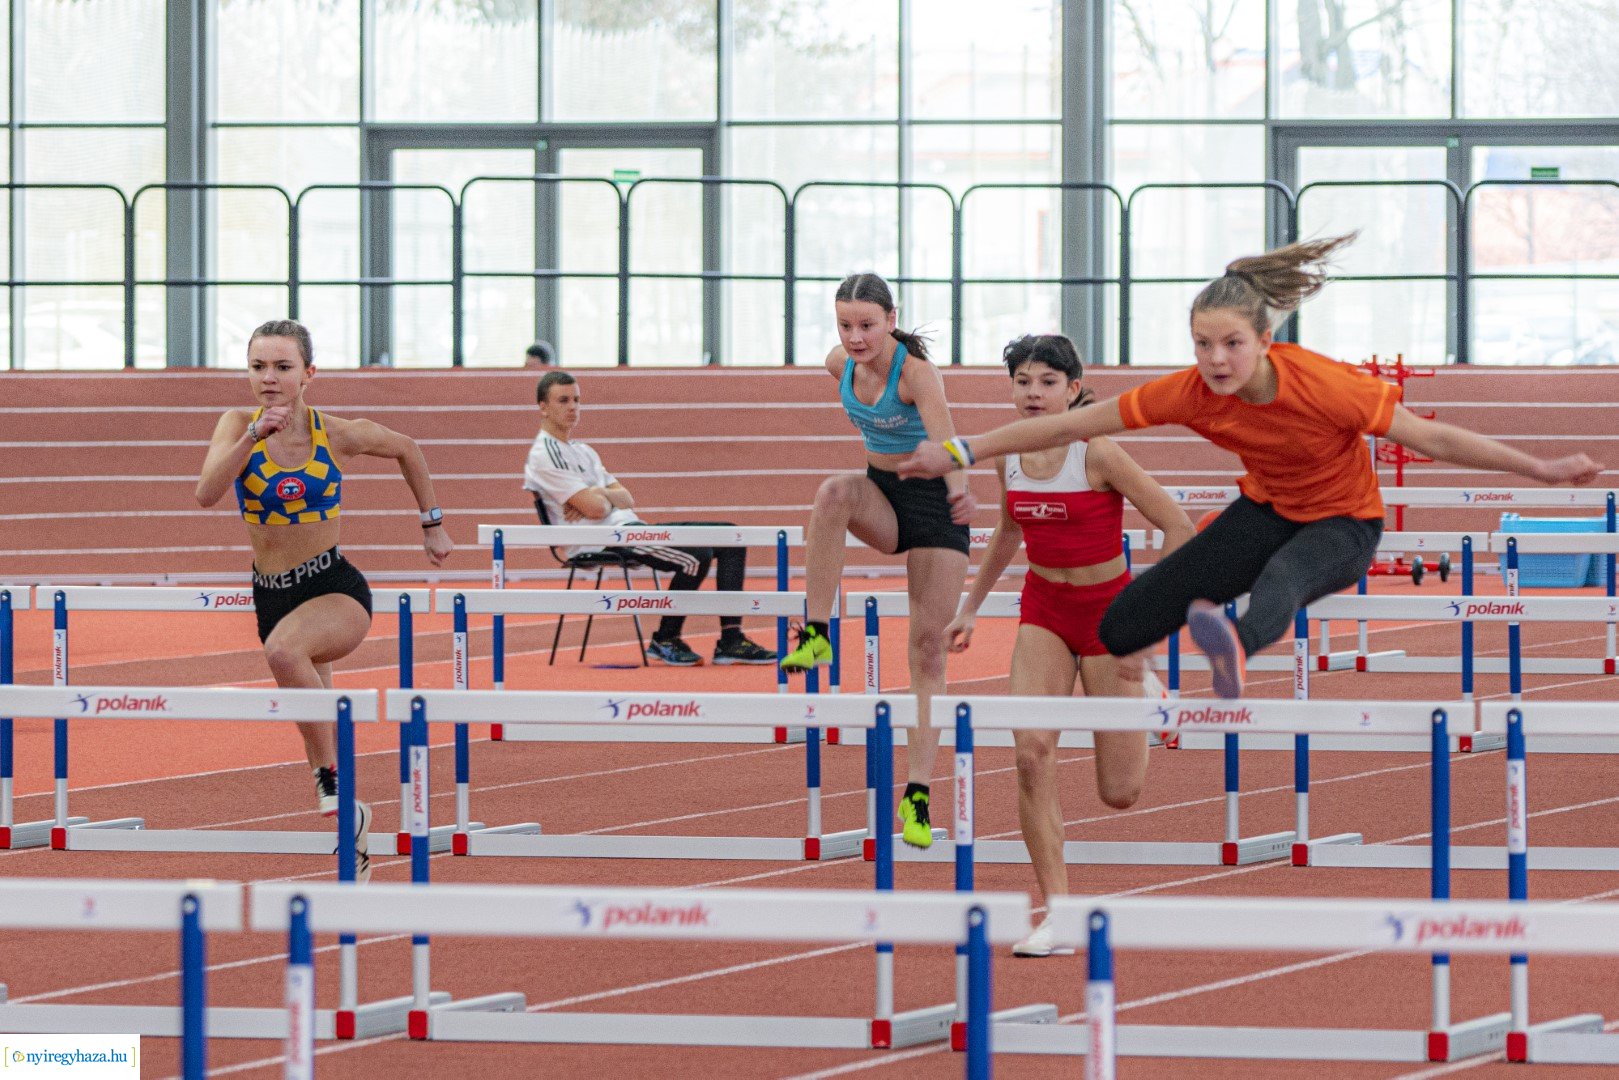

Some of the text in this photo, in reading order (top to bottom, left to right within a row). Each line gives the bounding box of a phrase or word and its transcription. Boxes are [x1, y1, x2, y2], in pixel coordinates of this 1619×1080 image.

[1188, 490, 1227, 501] polanik
[1474, 491, 1514, 502] polanik
[626, 531, 671, 543] polanik
[253, 551, 332, 589] NIKE PRO
[215, 593, 256, 608] polan
[617, 596, 674, 611] polanik
[1466, 602, 1525, 617] polanik
[455, 649, 464, 684] polanik
[866, 653, 875, 688] polanik
[1295, 655, 1304, 690] polanik
[96, 696, 168, 714] polanik
[627, 702, 702, 720] polanik
[1177, 707, 1253, 726] polanik
[412, 768, 424, 814] polanik
[956, 776, 968, 822] polanik
[1507, 784, 1520, 829] polanik
[603, 904, 711, 931] polanik
[1416, 916, 1528, 944] polanik
